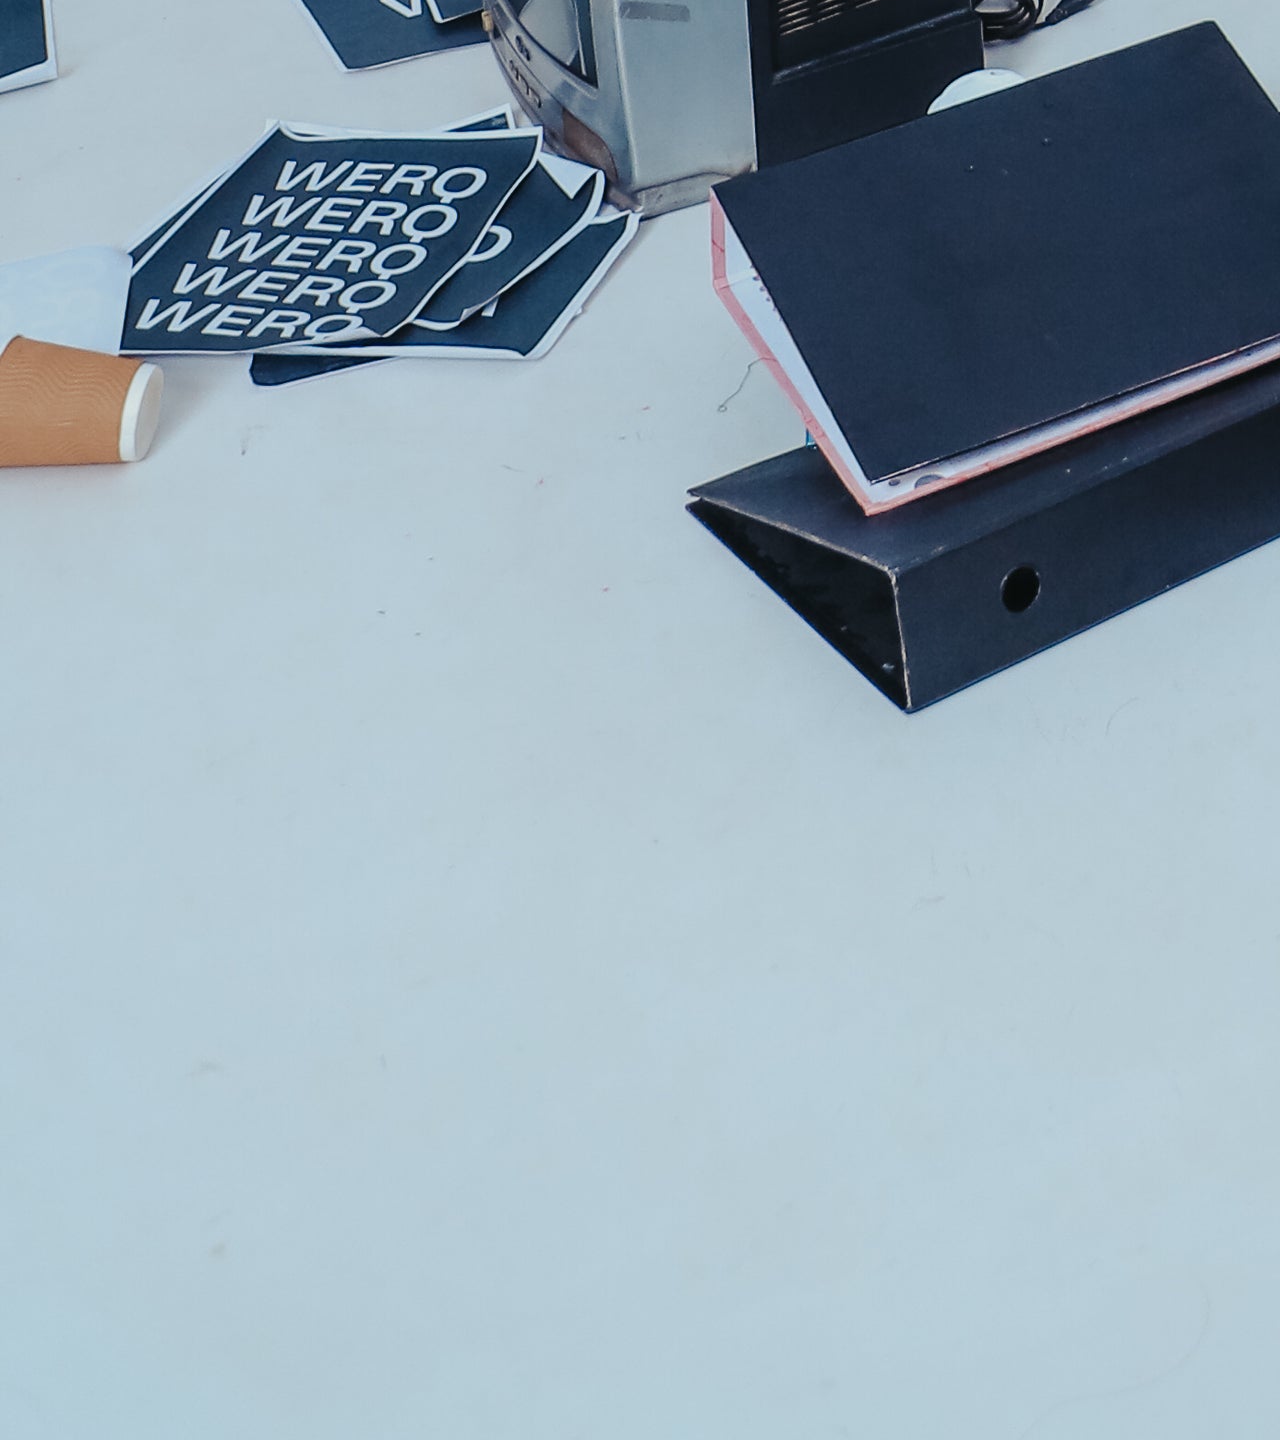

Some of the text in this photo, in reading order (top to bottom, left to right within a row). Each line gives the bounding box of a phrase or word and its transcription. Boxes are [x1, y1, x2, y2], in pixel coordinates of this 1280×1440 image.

[275, 160, 487, 203] WERQ
[241, 195, 458, 242] WERQ
[207, 228, 428, 281] WERQ
[172, 263, 397, 314] WERQ
